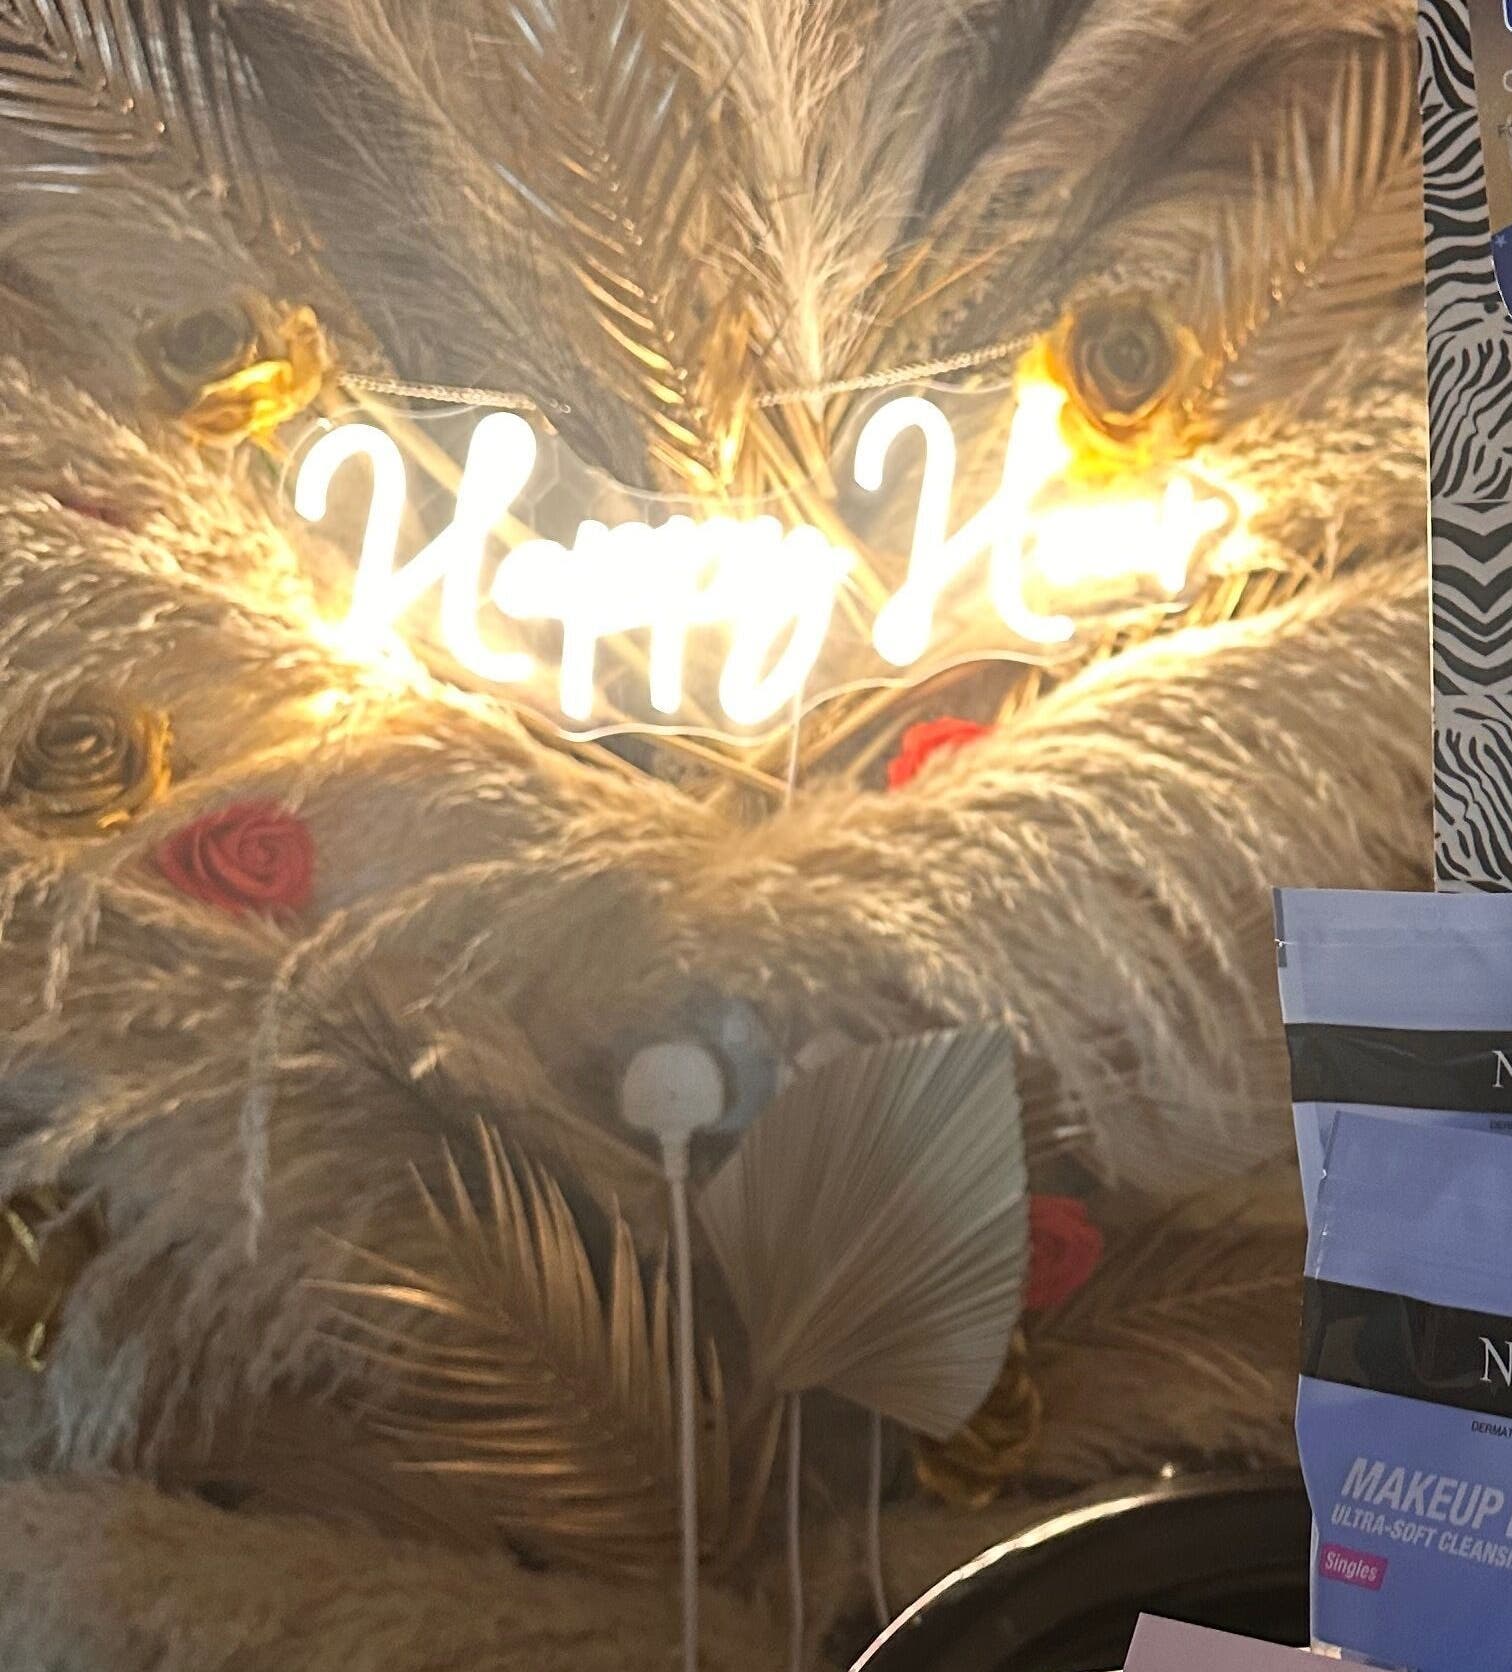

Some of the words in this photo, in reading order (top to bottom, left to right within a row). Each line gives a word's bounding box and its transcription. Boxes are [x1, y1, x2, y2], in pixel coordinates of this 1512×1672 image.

[1340, 1456, 1505, 1531] MAKEUP
[1330, 1503, 1439, 1550] ULTRA-SOFT
[1324, 1550, 1379, 1582] Singles
